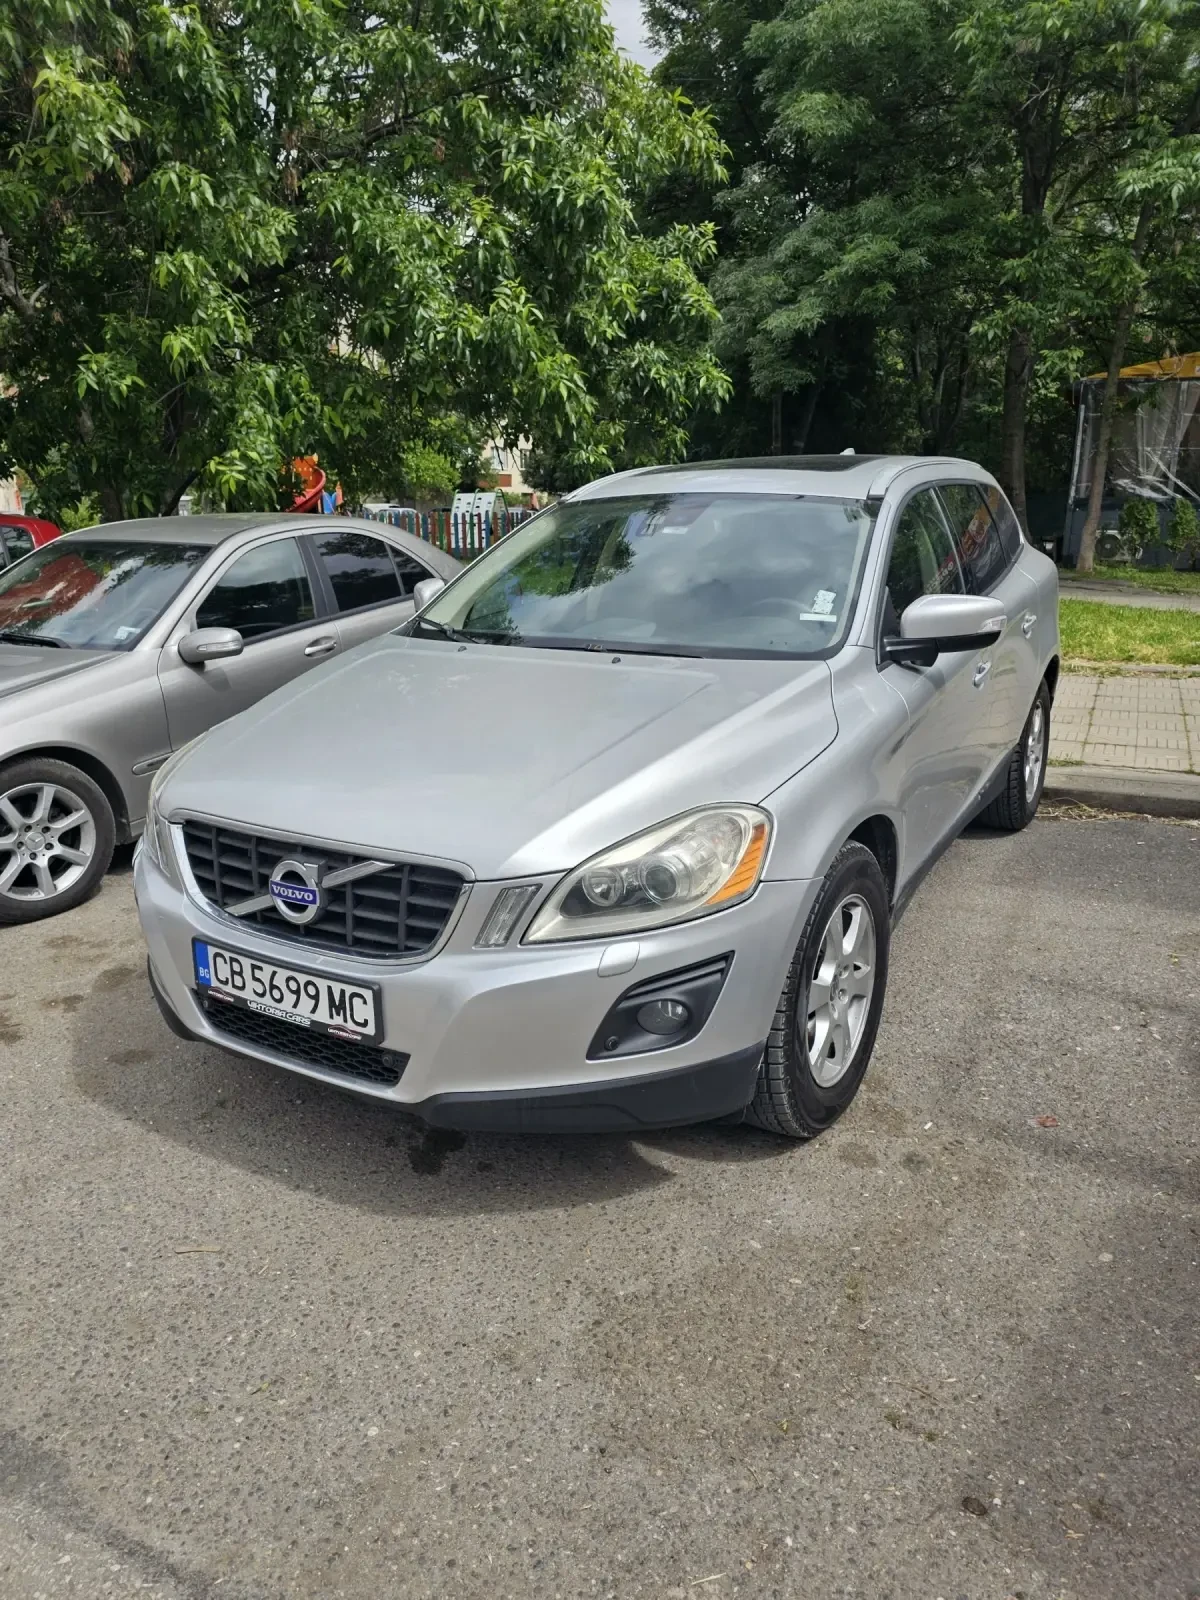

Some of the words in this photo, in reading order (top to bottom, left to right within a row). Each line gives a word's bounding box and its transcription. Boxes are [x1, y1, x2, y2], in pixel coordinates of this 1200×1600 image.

[272, 884, 313, 901] VOLVO
[199, 966, 210, 978] BG
[212, 951, 246, 991] CB
[250, 963, 320, 1014] 5699
[327, 985, 369, 1028] MC
[286, 1013, 311, 1025] CARS
